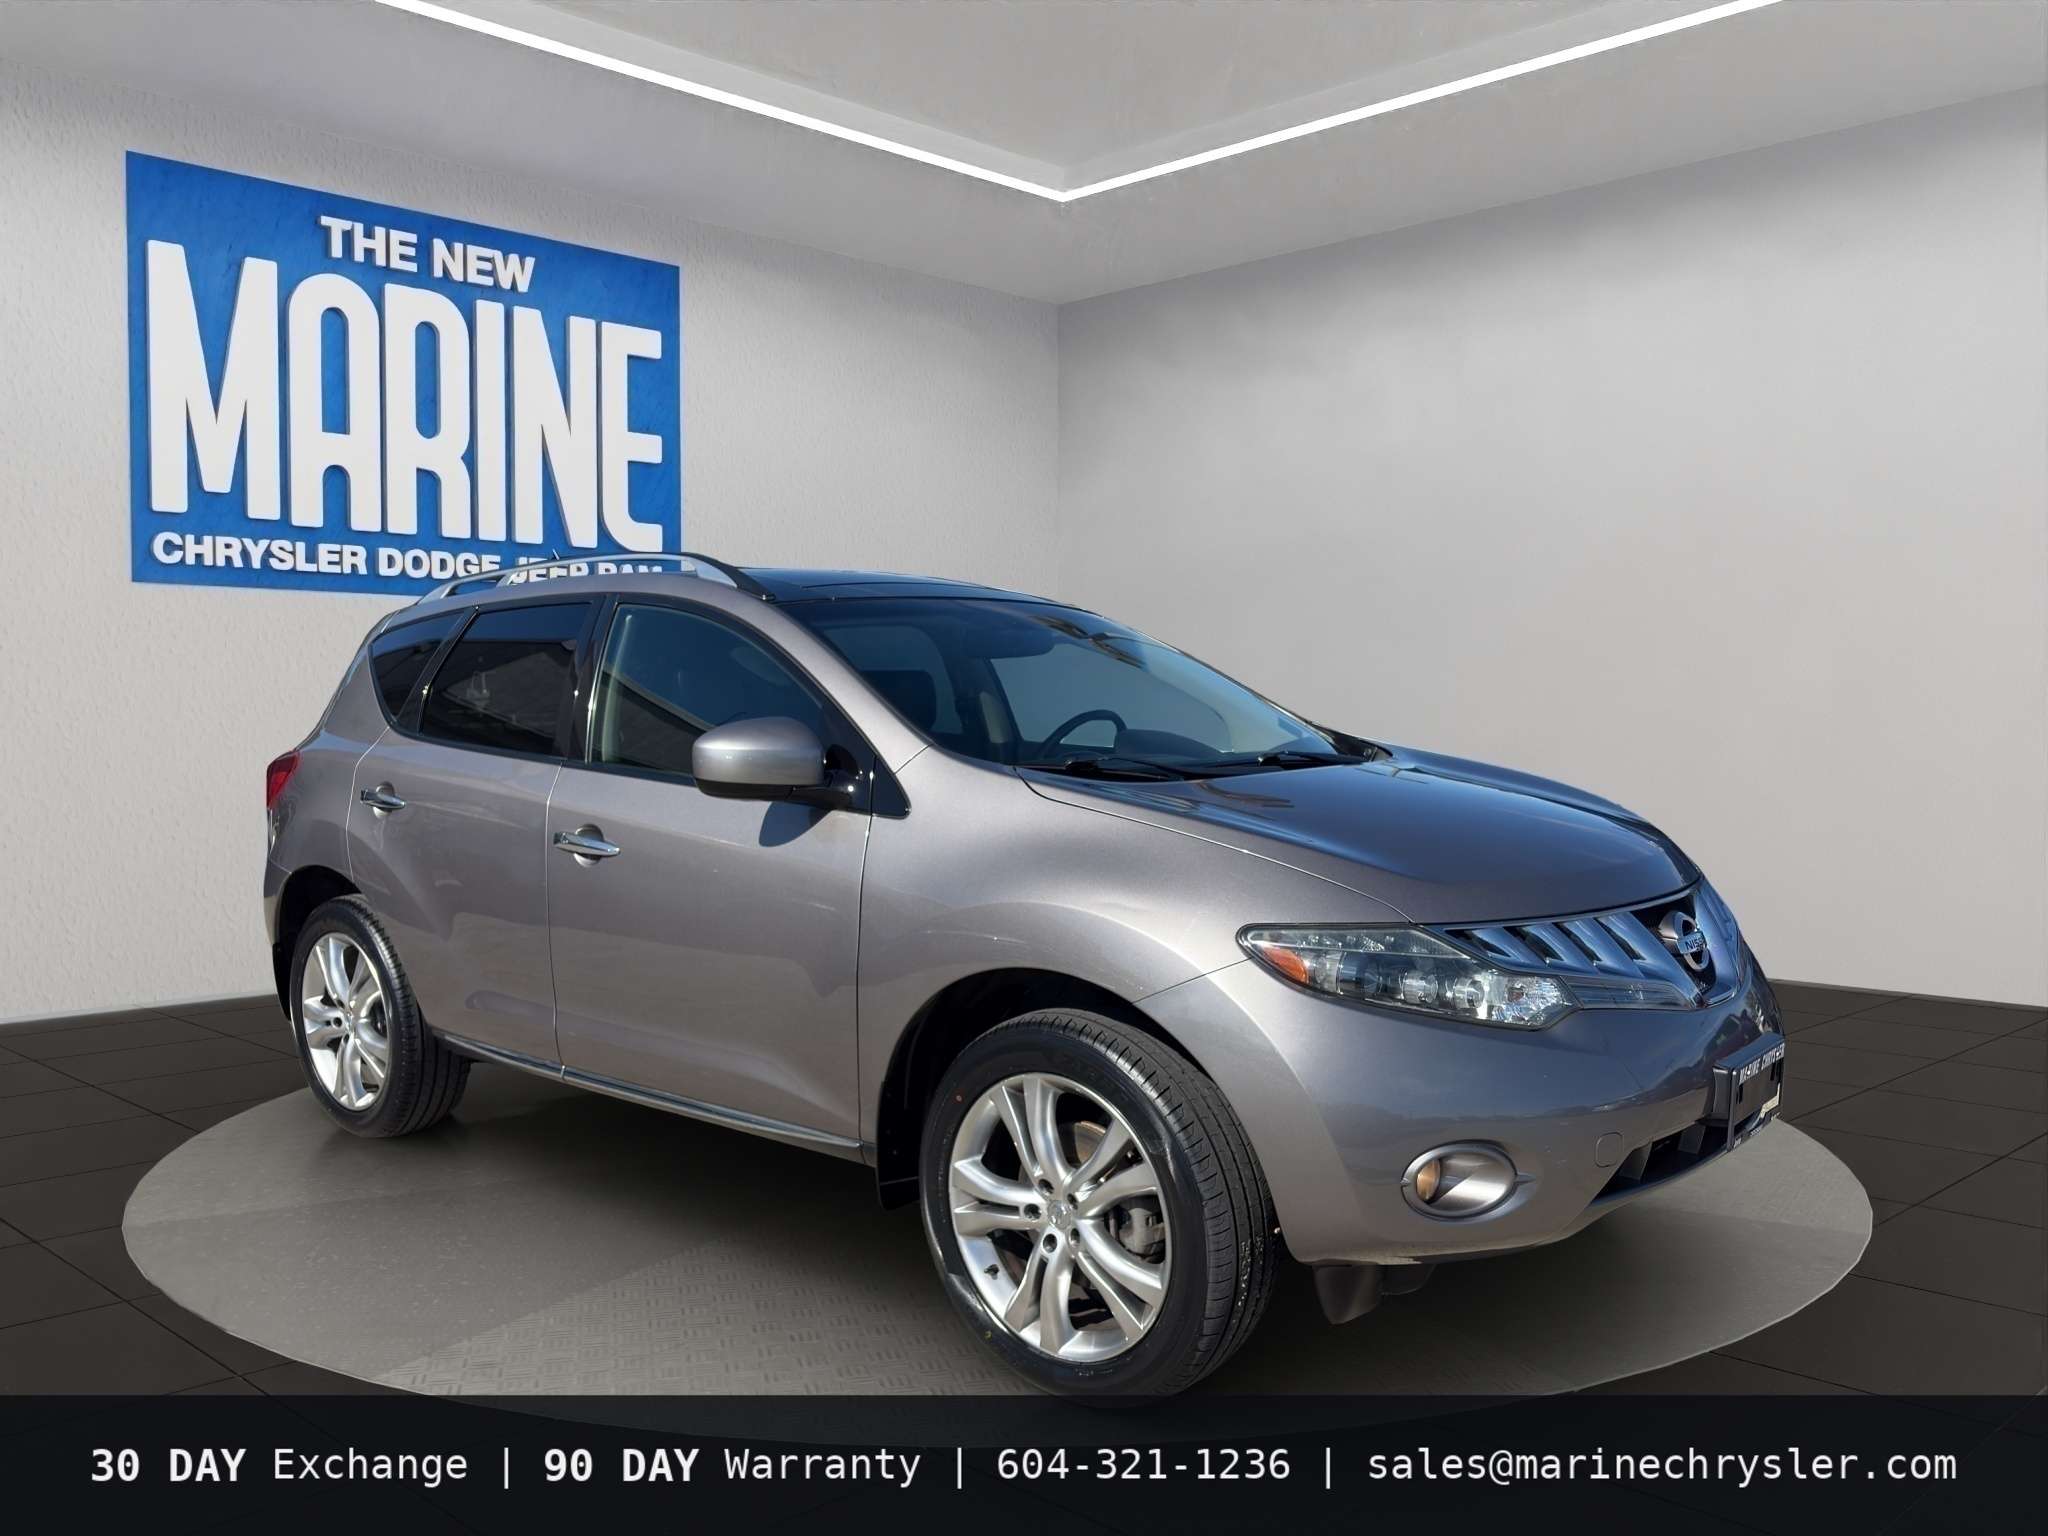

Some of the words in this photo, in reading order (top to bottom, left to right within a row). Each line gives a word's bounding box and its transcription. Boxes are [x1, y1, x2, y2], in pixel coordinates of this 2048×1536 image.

[320, 215, 418, 273] THE
[432, 238, 536, 293] NEW
[146, 239, 663, 553] MARINE
[152, 531, 368, 575] CHRYSLER
[378, 547, 501, 581] DODGE
